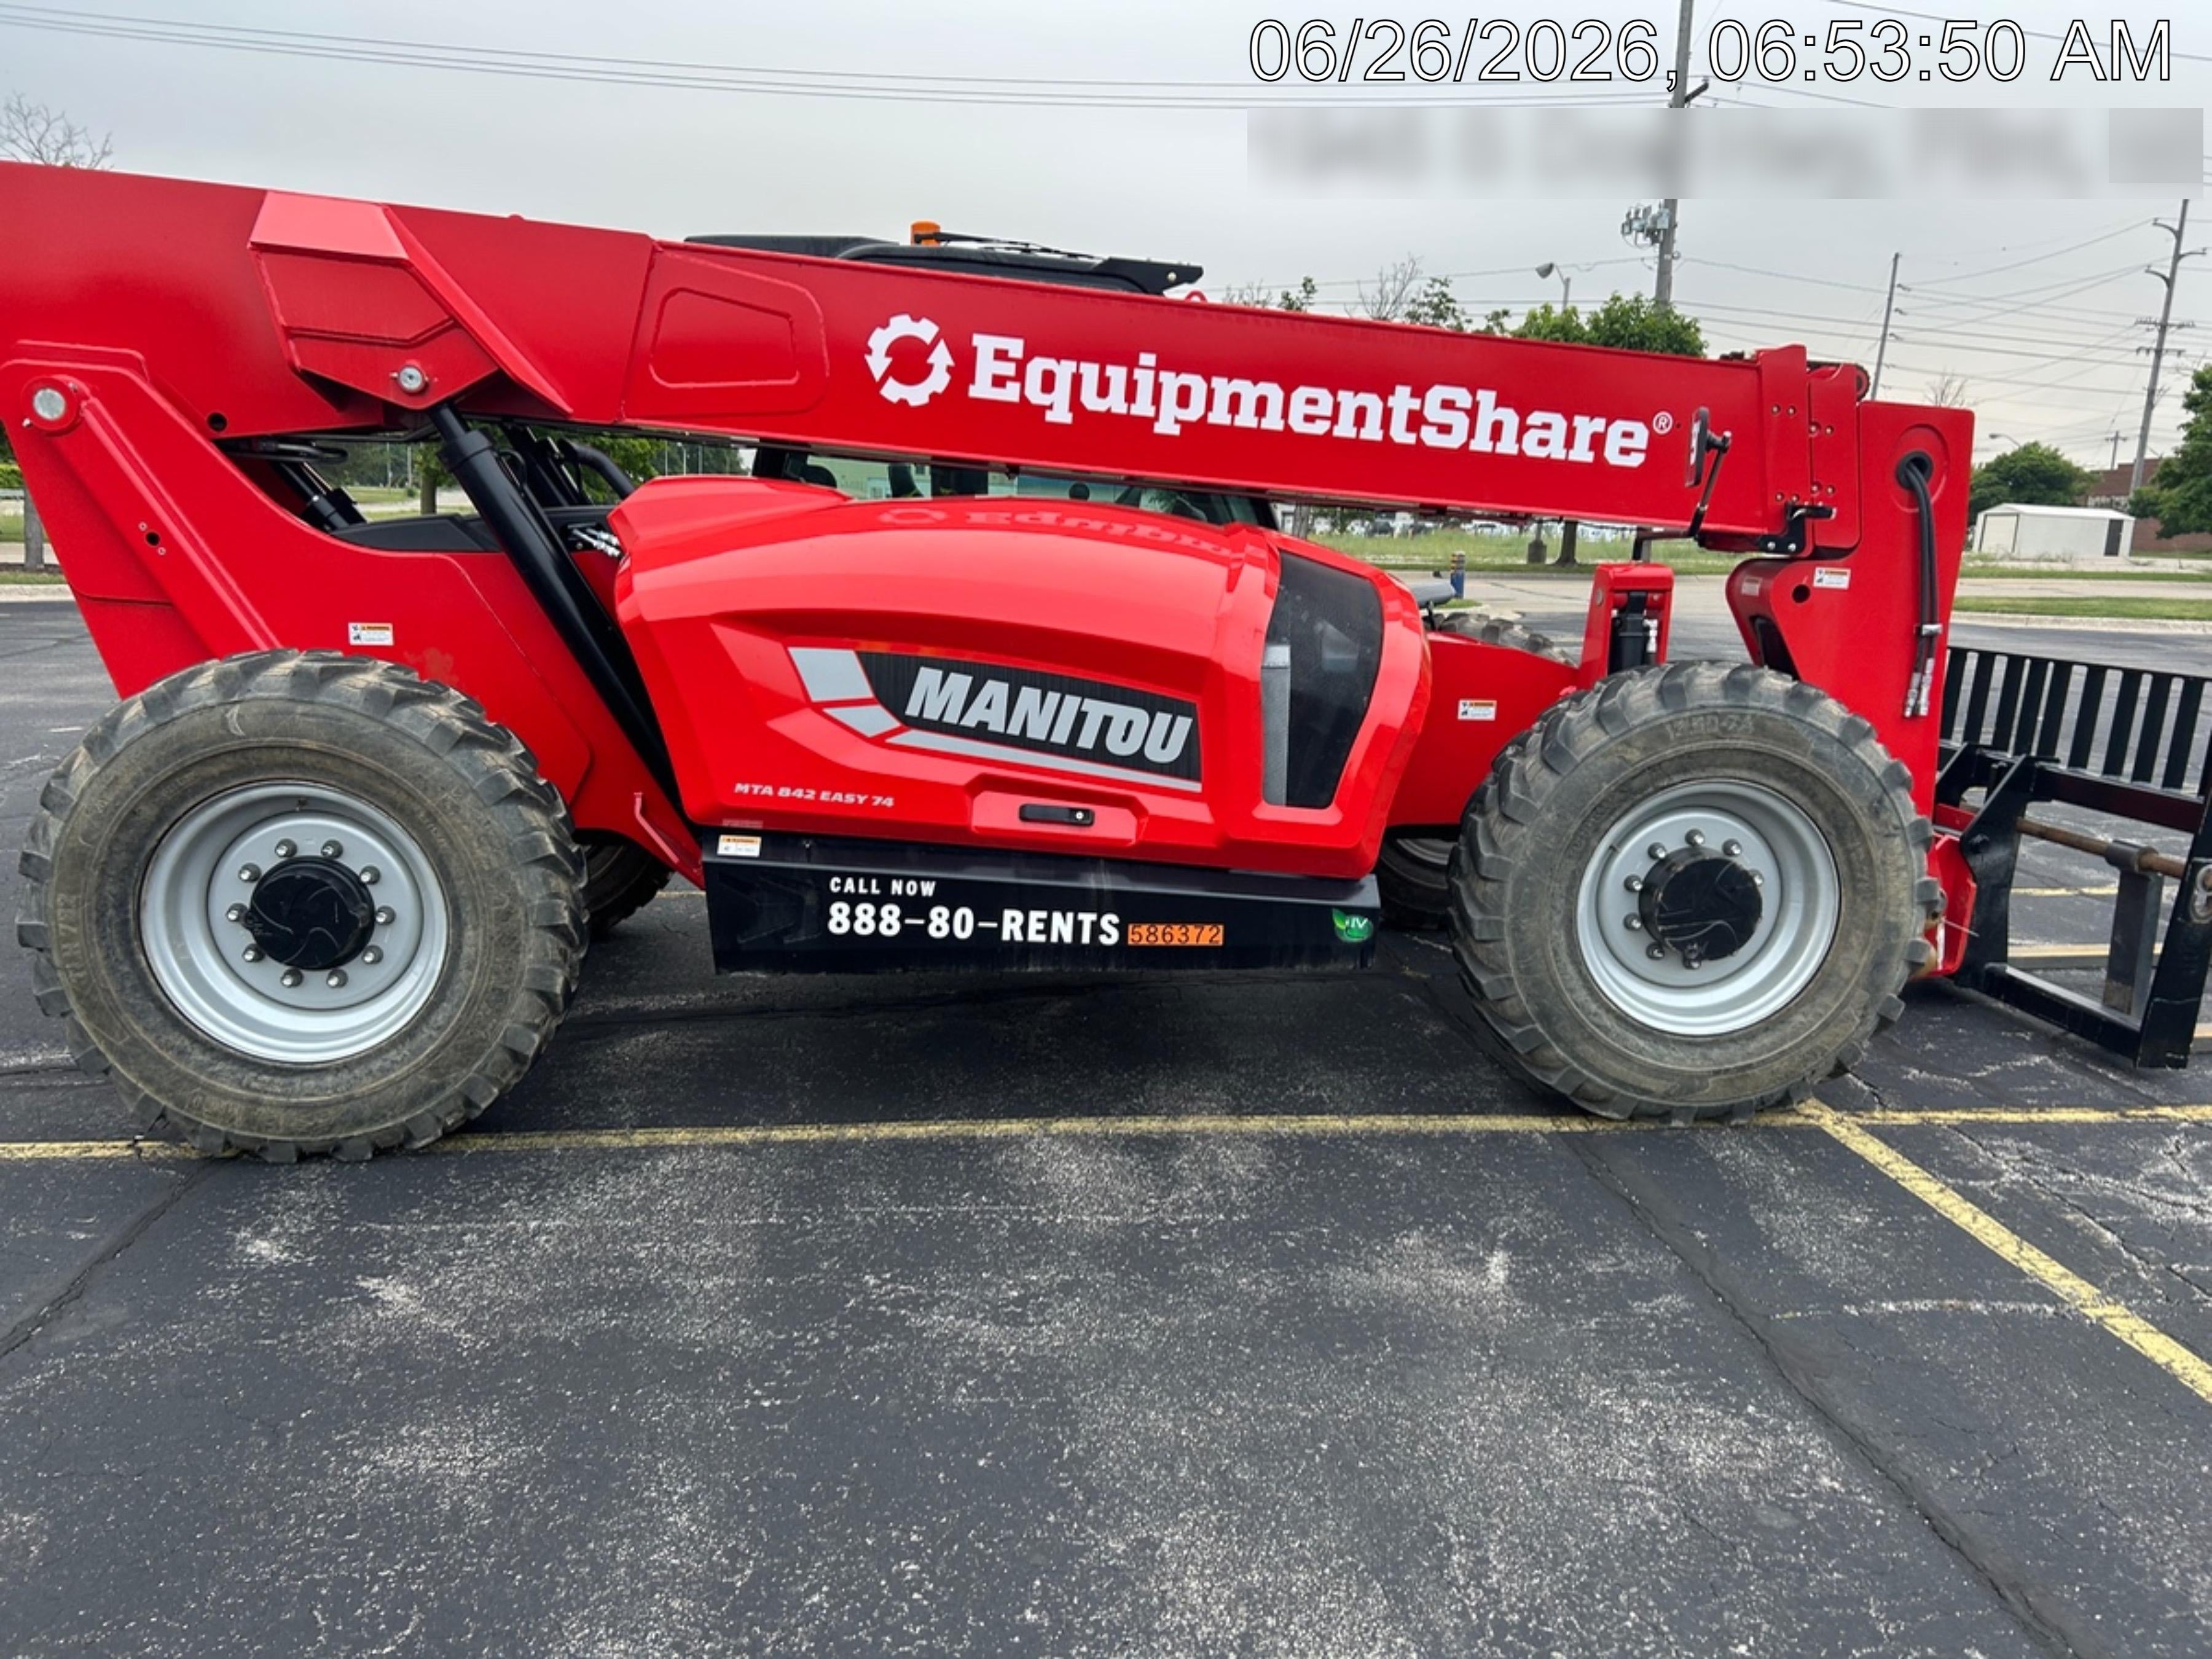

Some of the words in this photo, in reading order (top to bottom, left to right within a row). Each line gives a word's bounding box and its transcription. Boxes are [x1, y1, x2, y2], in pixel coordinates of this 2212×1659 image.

[904, 666, 1193, 764] MANITOU
[734, 783, 774, 797] MTA
[777, 786, 817, 801] 842
[819, 790, 869, 807] EASY
[871, 795, 895, 808] 74
[829, 877, 880, 895] CALL
[891, 880, 936, 897] NOW
[828, 901, 1120, 946] 888-80-RENTS
[1130, 924, 1222, 945] 586372
